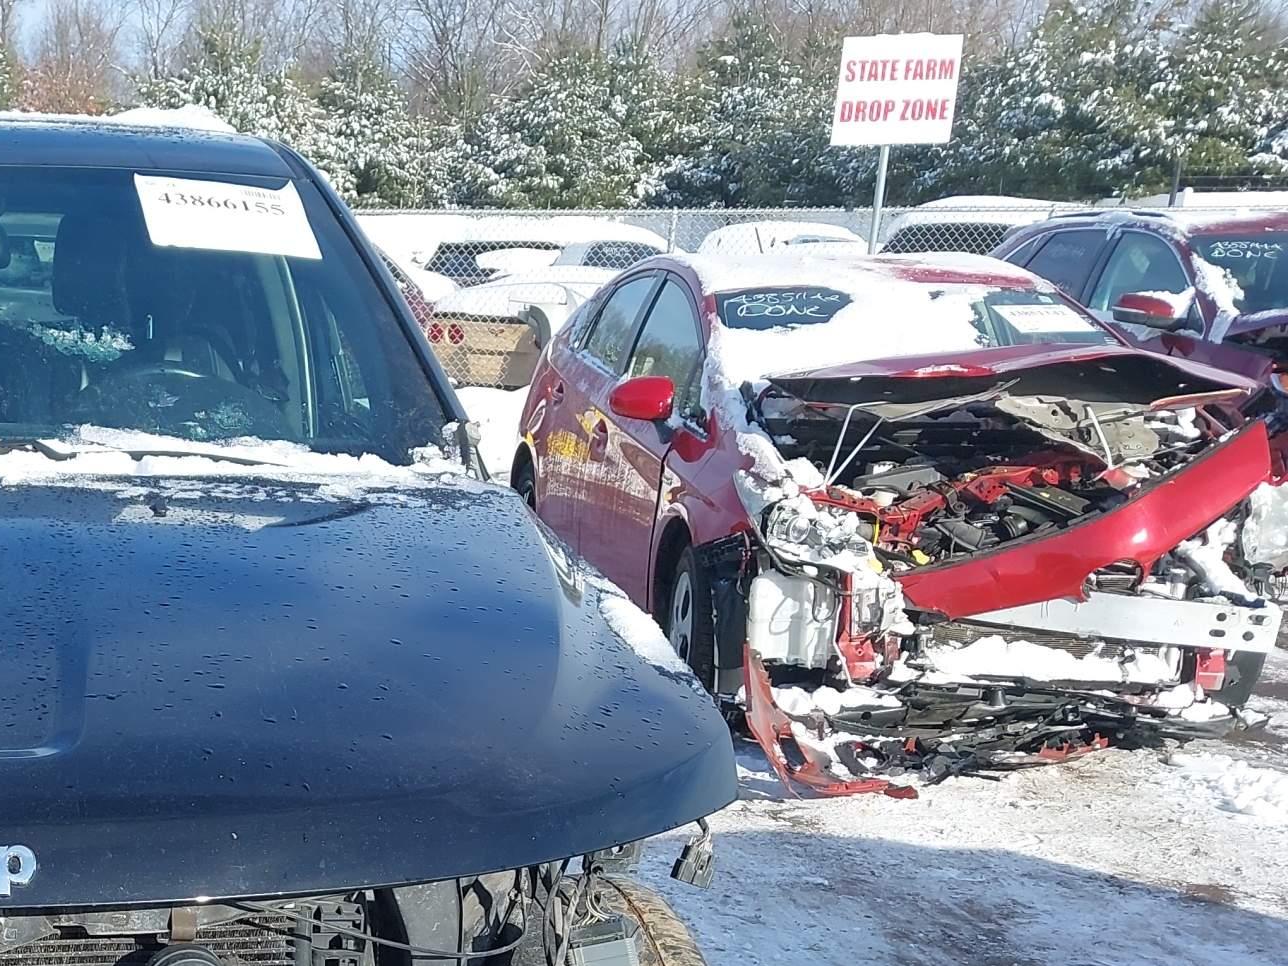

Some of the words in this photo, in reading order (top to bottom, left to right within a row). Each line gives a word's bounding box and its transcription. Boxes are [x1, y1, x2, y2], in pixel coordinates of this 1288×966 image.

[845, 59, 900, 82] STATE
[904, 57, 956, 81] FARM
[839, 99, 896, 123] DROP
[898, 98, 950, 121] ZONE
[158, 191, 286, 217] 43866155
[737, 303, 829, 317] DONE
